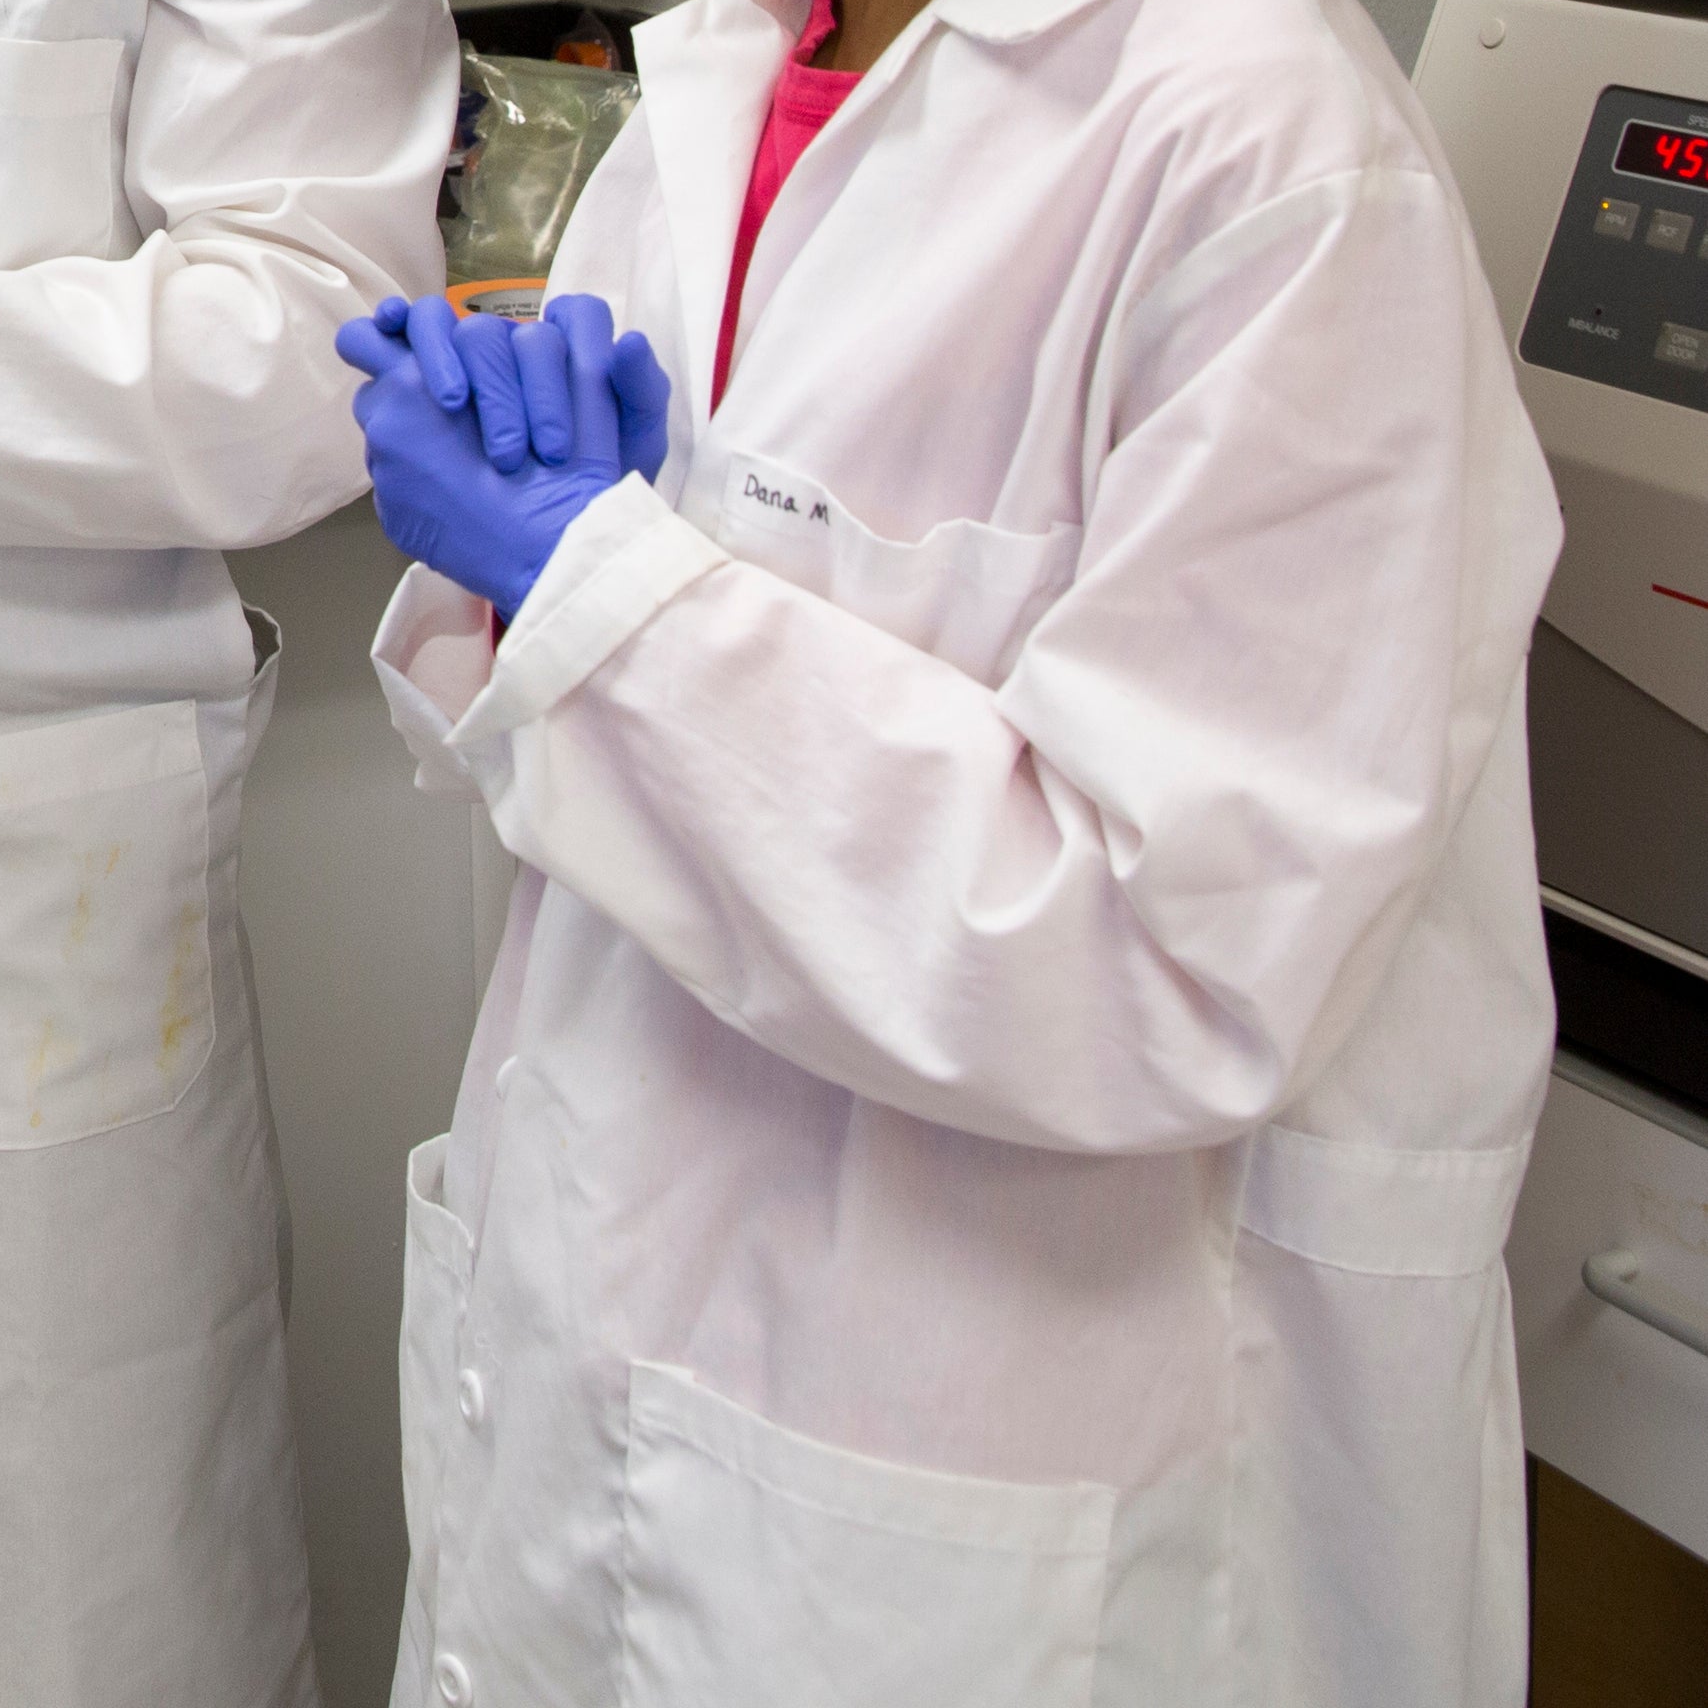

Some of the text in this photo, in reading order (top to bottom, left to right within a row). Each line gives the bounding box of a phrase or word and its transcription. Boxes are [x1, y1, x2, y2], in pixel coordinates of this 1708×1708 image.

[1655, 135, 1708, 179] 45
[744, 474, 829, 527] Dana M
